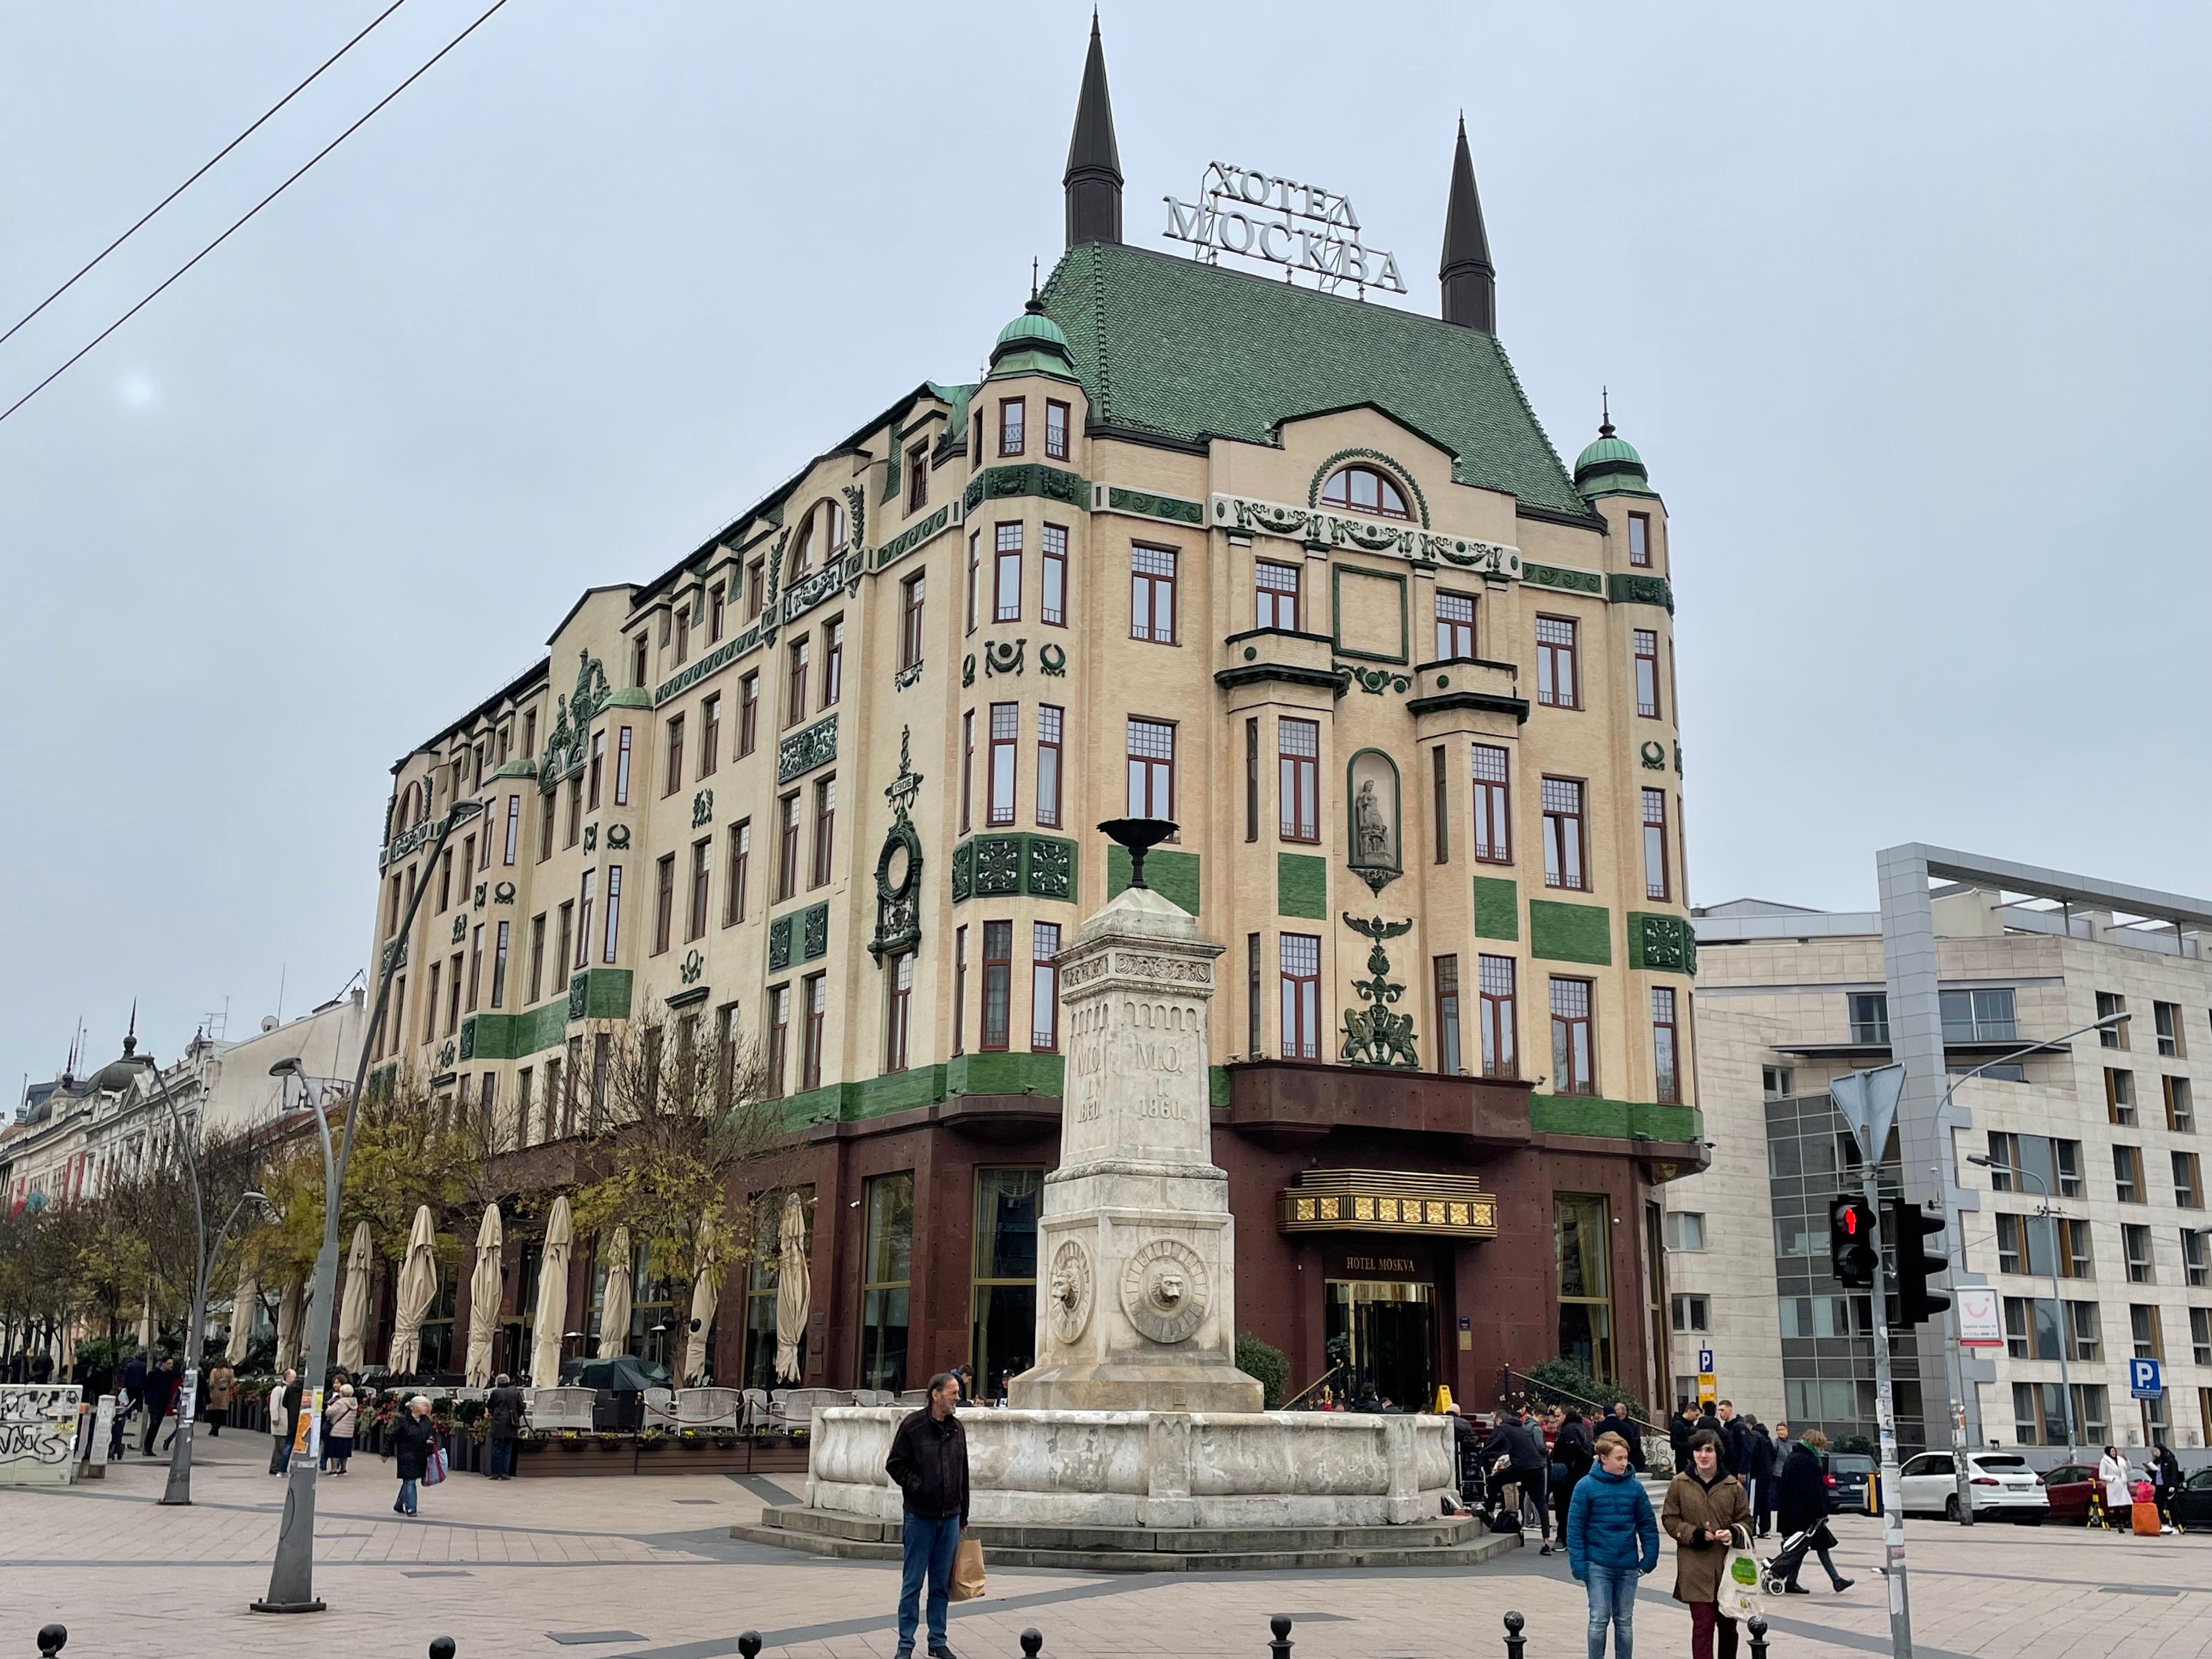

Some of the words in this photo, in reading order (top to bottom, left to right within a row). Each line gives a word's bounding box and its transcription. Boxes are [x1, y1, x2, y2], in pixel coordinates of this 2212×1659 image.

[1209, 160, 1361, 230] ХОТЕЛ
[1162, 195, 1409, 295] МОСКВА
[894, 778, 912, 793] 1906
[1346, 1257, 1376, 1270] HOTEL
[1378, 1259, 1415, 1272] MOSKVA
[1702, 1352, 1710, 1370] P
[2136, 1362, 2153, 1387] P
